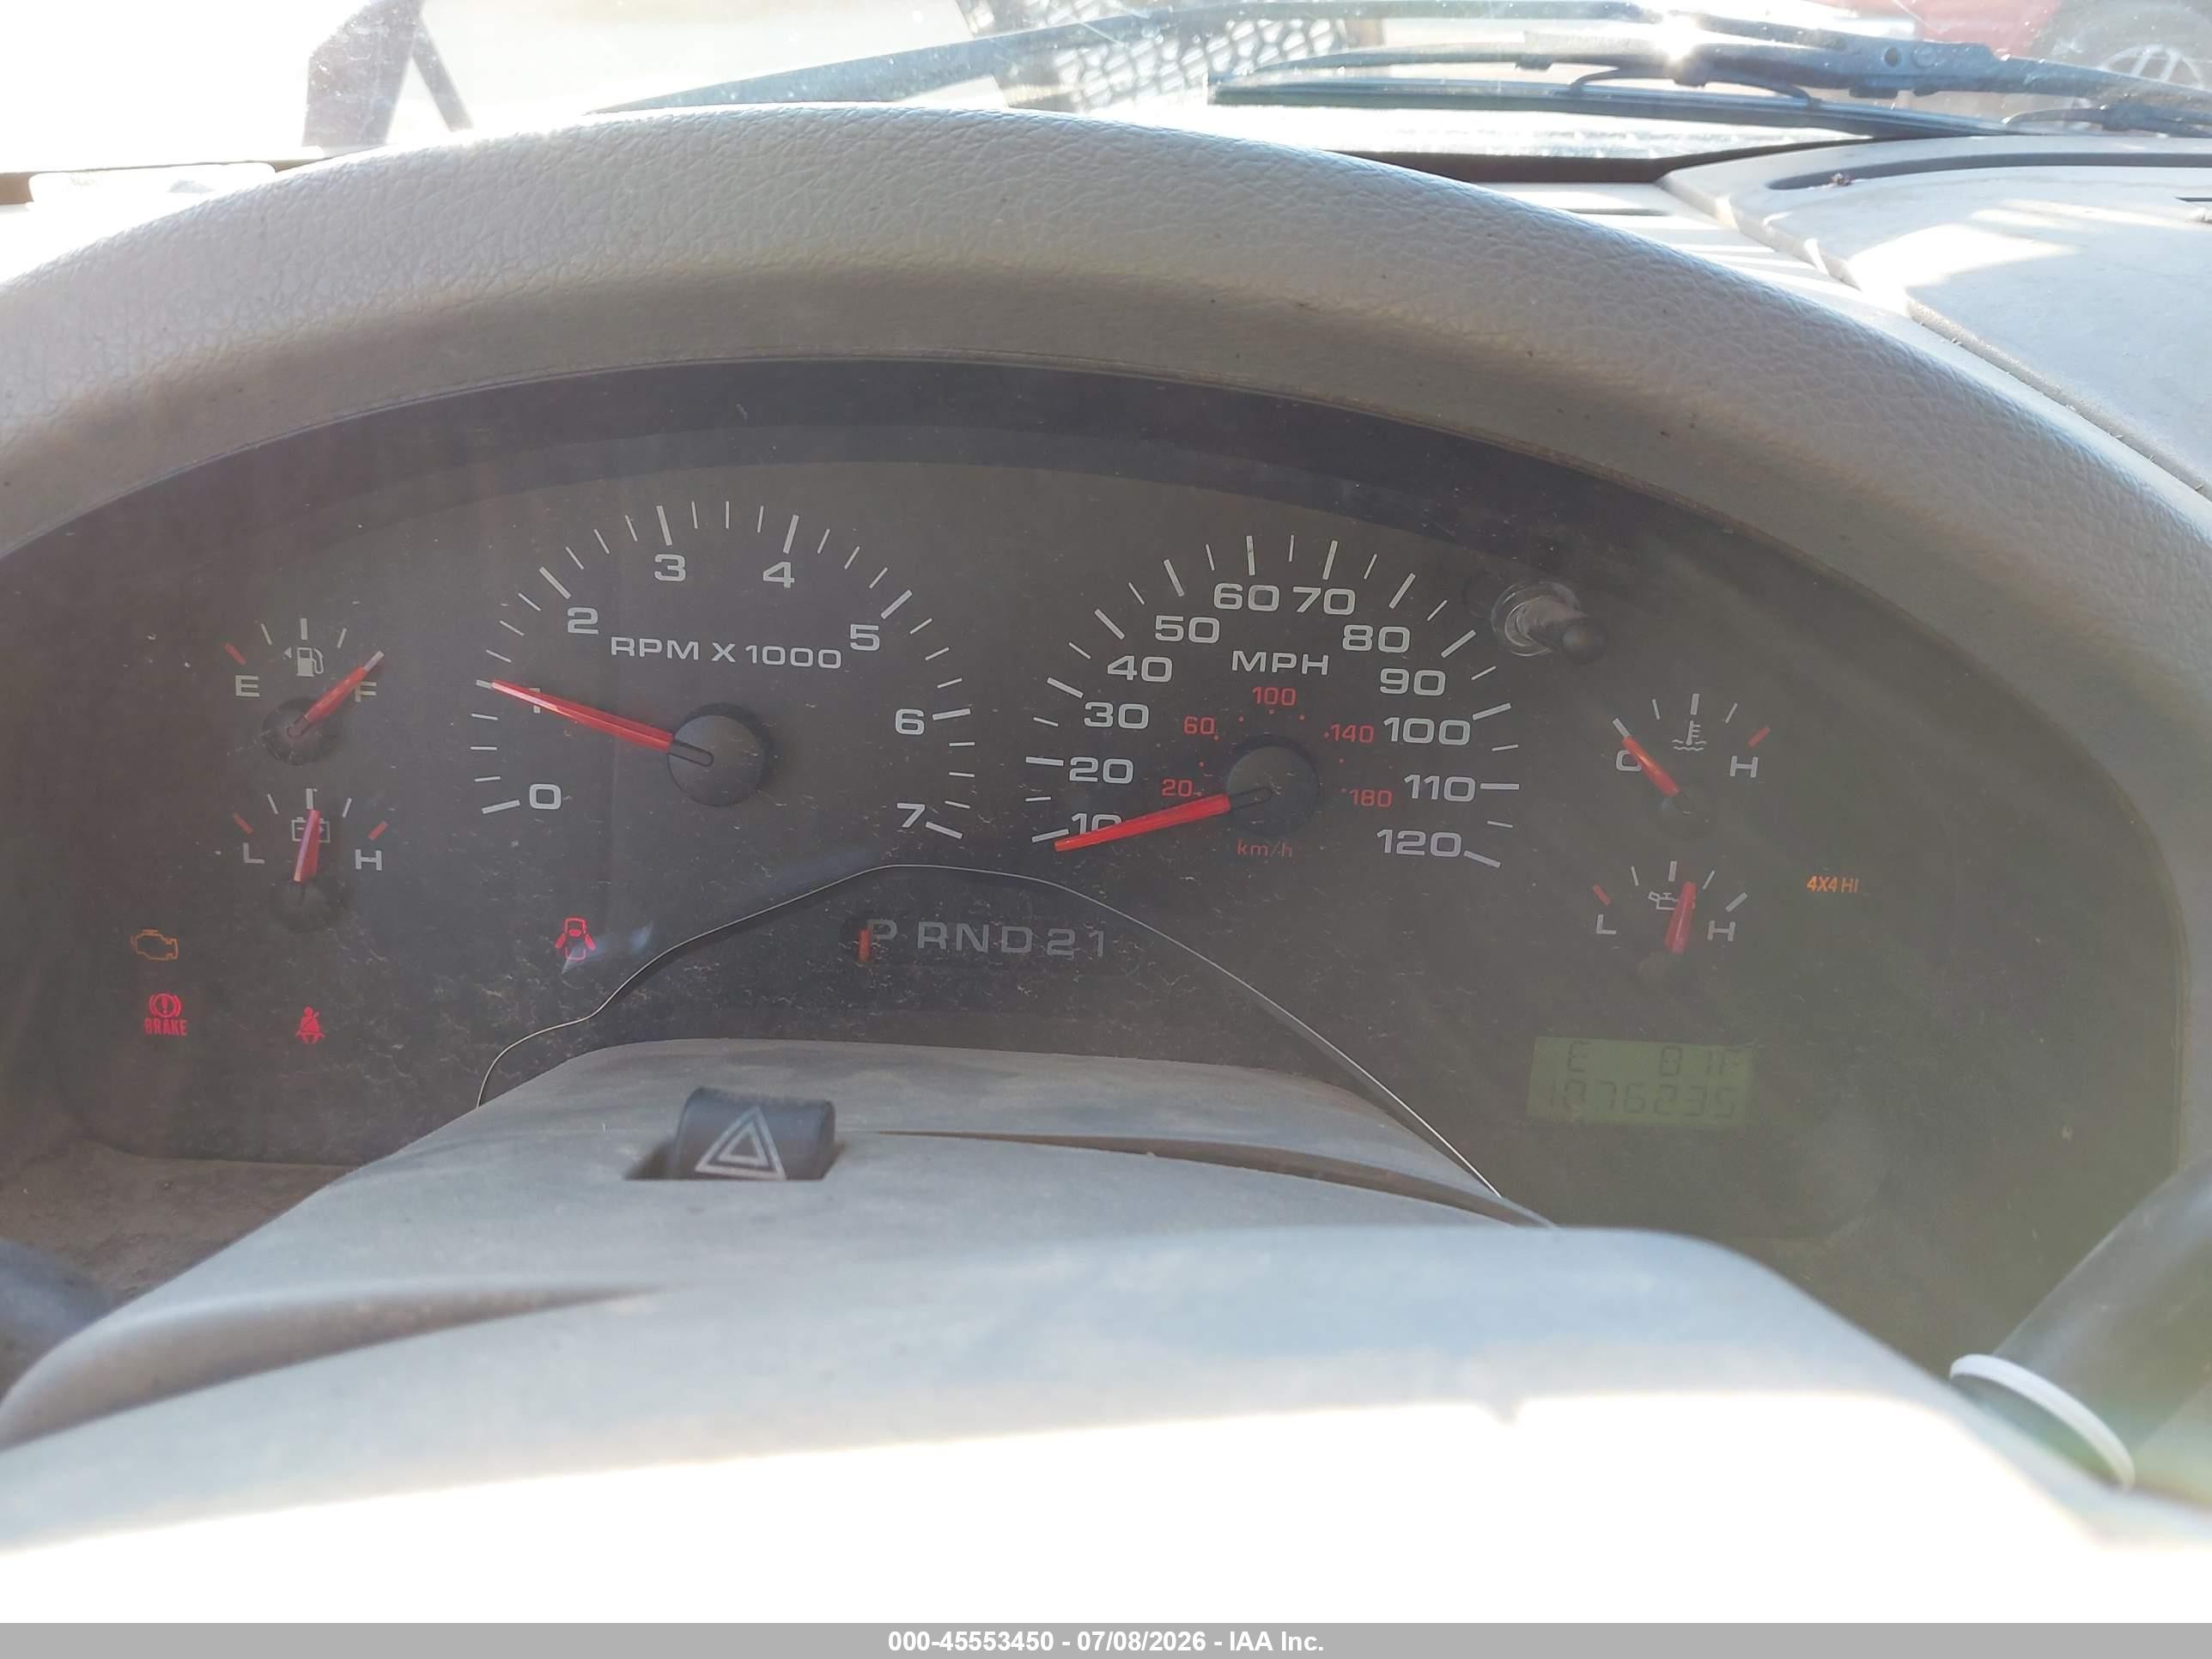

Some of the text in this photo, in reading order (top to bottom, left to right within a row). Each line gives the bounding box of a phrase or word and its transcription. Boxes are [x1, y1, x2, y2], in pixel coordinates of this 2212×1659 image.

[653, 554, 686, 581] 3
[763, 562, 795, 588] 4
[1213, 583, 1279, 612] 60
[1292, 586, 1356, 616] 70
[568, 607, 599, 634] 2
[1155, 616, 1220, 643] 50
[849, 623, 880, 652] 5
[1342, 625, 1410, 653] 80
[611, 636, 842, 669] RPM X 1000
[1232, 651, 1329, 675] MPH
[1107, 656, 1173, 684] 40
[1380, 668, 1445, 696] 90
[234, 675, 260, 698] E
[355, 681, 377, 702] F
[1252, 688, 1297, 706] 100
[895, 708, 926, 736] 6
[1084, 702, 1149, 730] 30
[1183, 717, 1216, 735] 60
[1331, 724, 1375, 744] 140
[1383, 718, 1471, 745] 100
[1068, 757, 1133, 784] 20
[1729, 756, 1759, 778] H
[529, 783, 562, 811] 0
[1162, 780, 1193, 798] 20
[1348, 788, 1392, 808] 180
[1404, 775, 1475, 803] 110
[896, 804, 927, 828] 7
[242, 842, 265, 865] L
[1237, 839, 1293, 858] km/h
[1376, 830, 1462, 857] 120
[355, 848, 383, 872] H
[1806, 876, 1838, 893] 4X4
[1595, 914, 1617, 935] L
[1707, 921, 1736, 942] H
[143, 1018, 188, 1036] BRAKE
